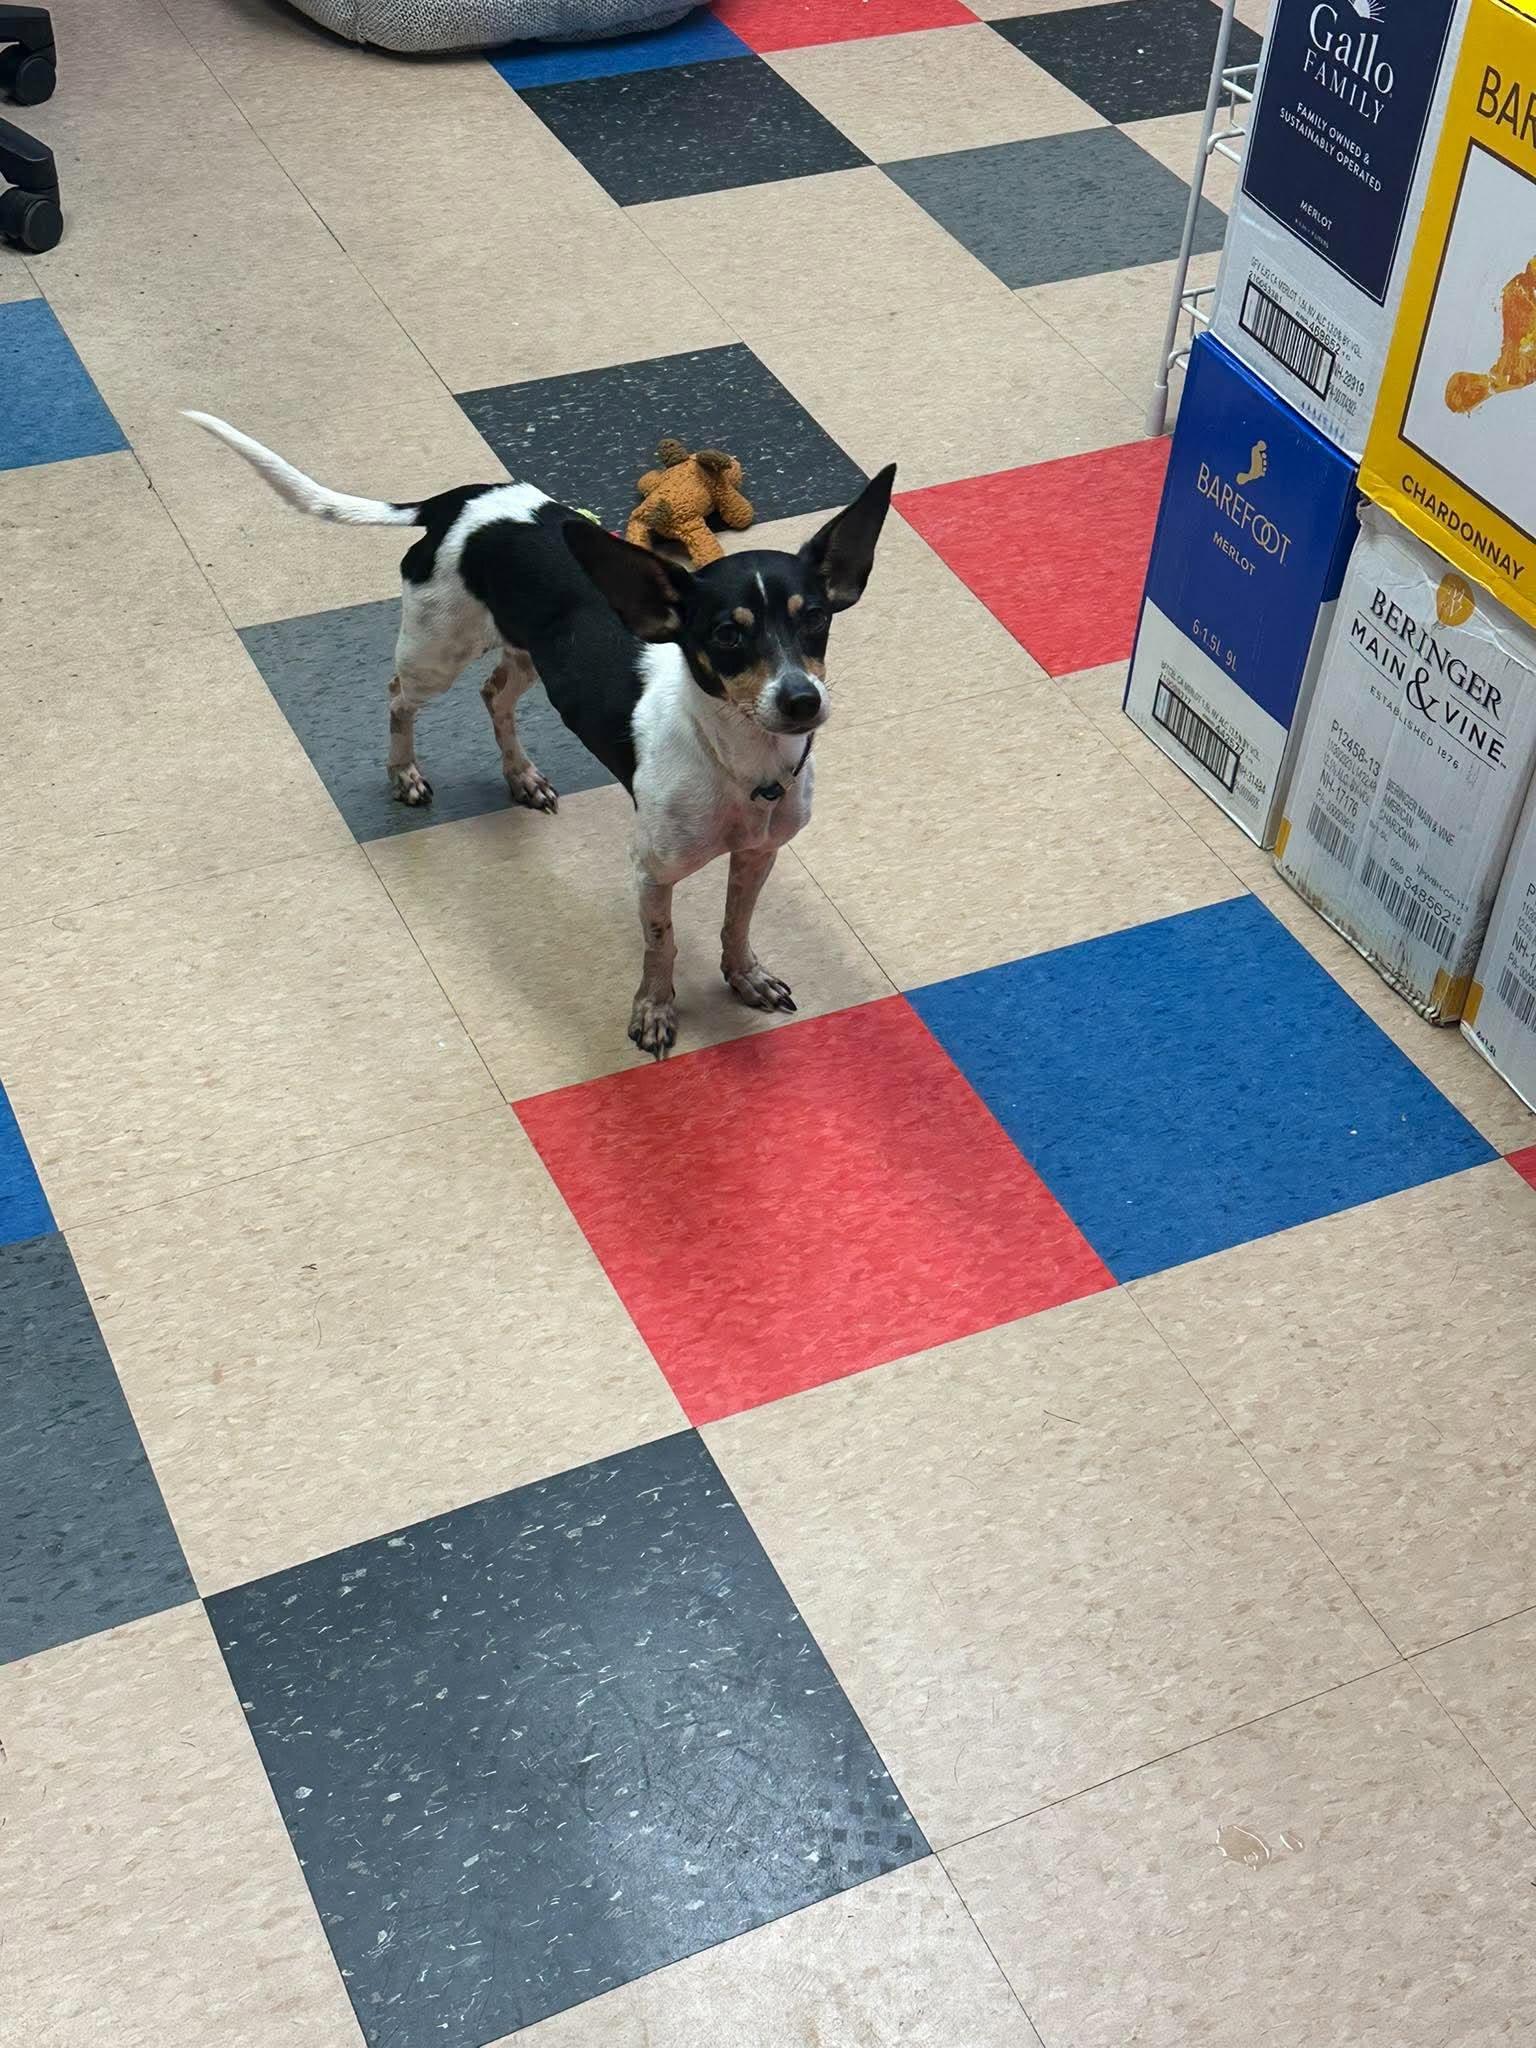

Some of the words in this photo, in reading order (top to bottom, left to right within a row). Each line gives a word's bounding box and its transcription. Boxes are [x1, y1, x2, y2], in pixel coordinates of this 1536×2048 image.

[1309, 3, 1394, 94] Gallo
[1303, 48, 1385, 125] FAMILY
[1476, 65, 1536, 149] BAR
[1279, 107, 1335, 156] SUSTAINABLY
[1336, 152, 1382, 192] OPERATED
[1297, 102, 1328, 132] FAMILY
[1329, 126, 1362, 159] OWNED
[1363, 153, 1371, 166] &
[1300, 200, 1332, 231] MERLOT
[1197, 462, 1292, 565] BAREFOOT
[1401, 474, 1525, 581] CHARDONNAY
[1213, 531, 1255, 576] MERLOT
[1225, 650, 1238, 672] 9L
[1351, 618, 1406, 681] MAIN
[1370, 587, 1502, 720] BERINGER
[1369, 685, 1433, 747] ESTABLISHED
[1437, 746, 1460, 770] 1876
[1406, 666, 1440, 723] &
[1443, 701, 1506, 764] VINE
[1403, 875, 1450, 924] 548562
